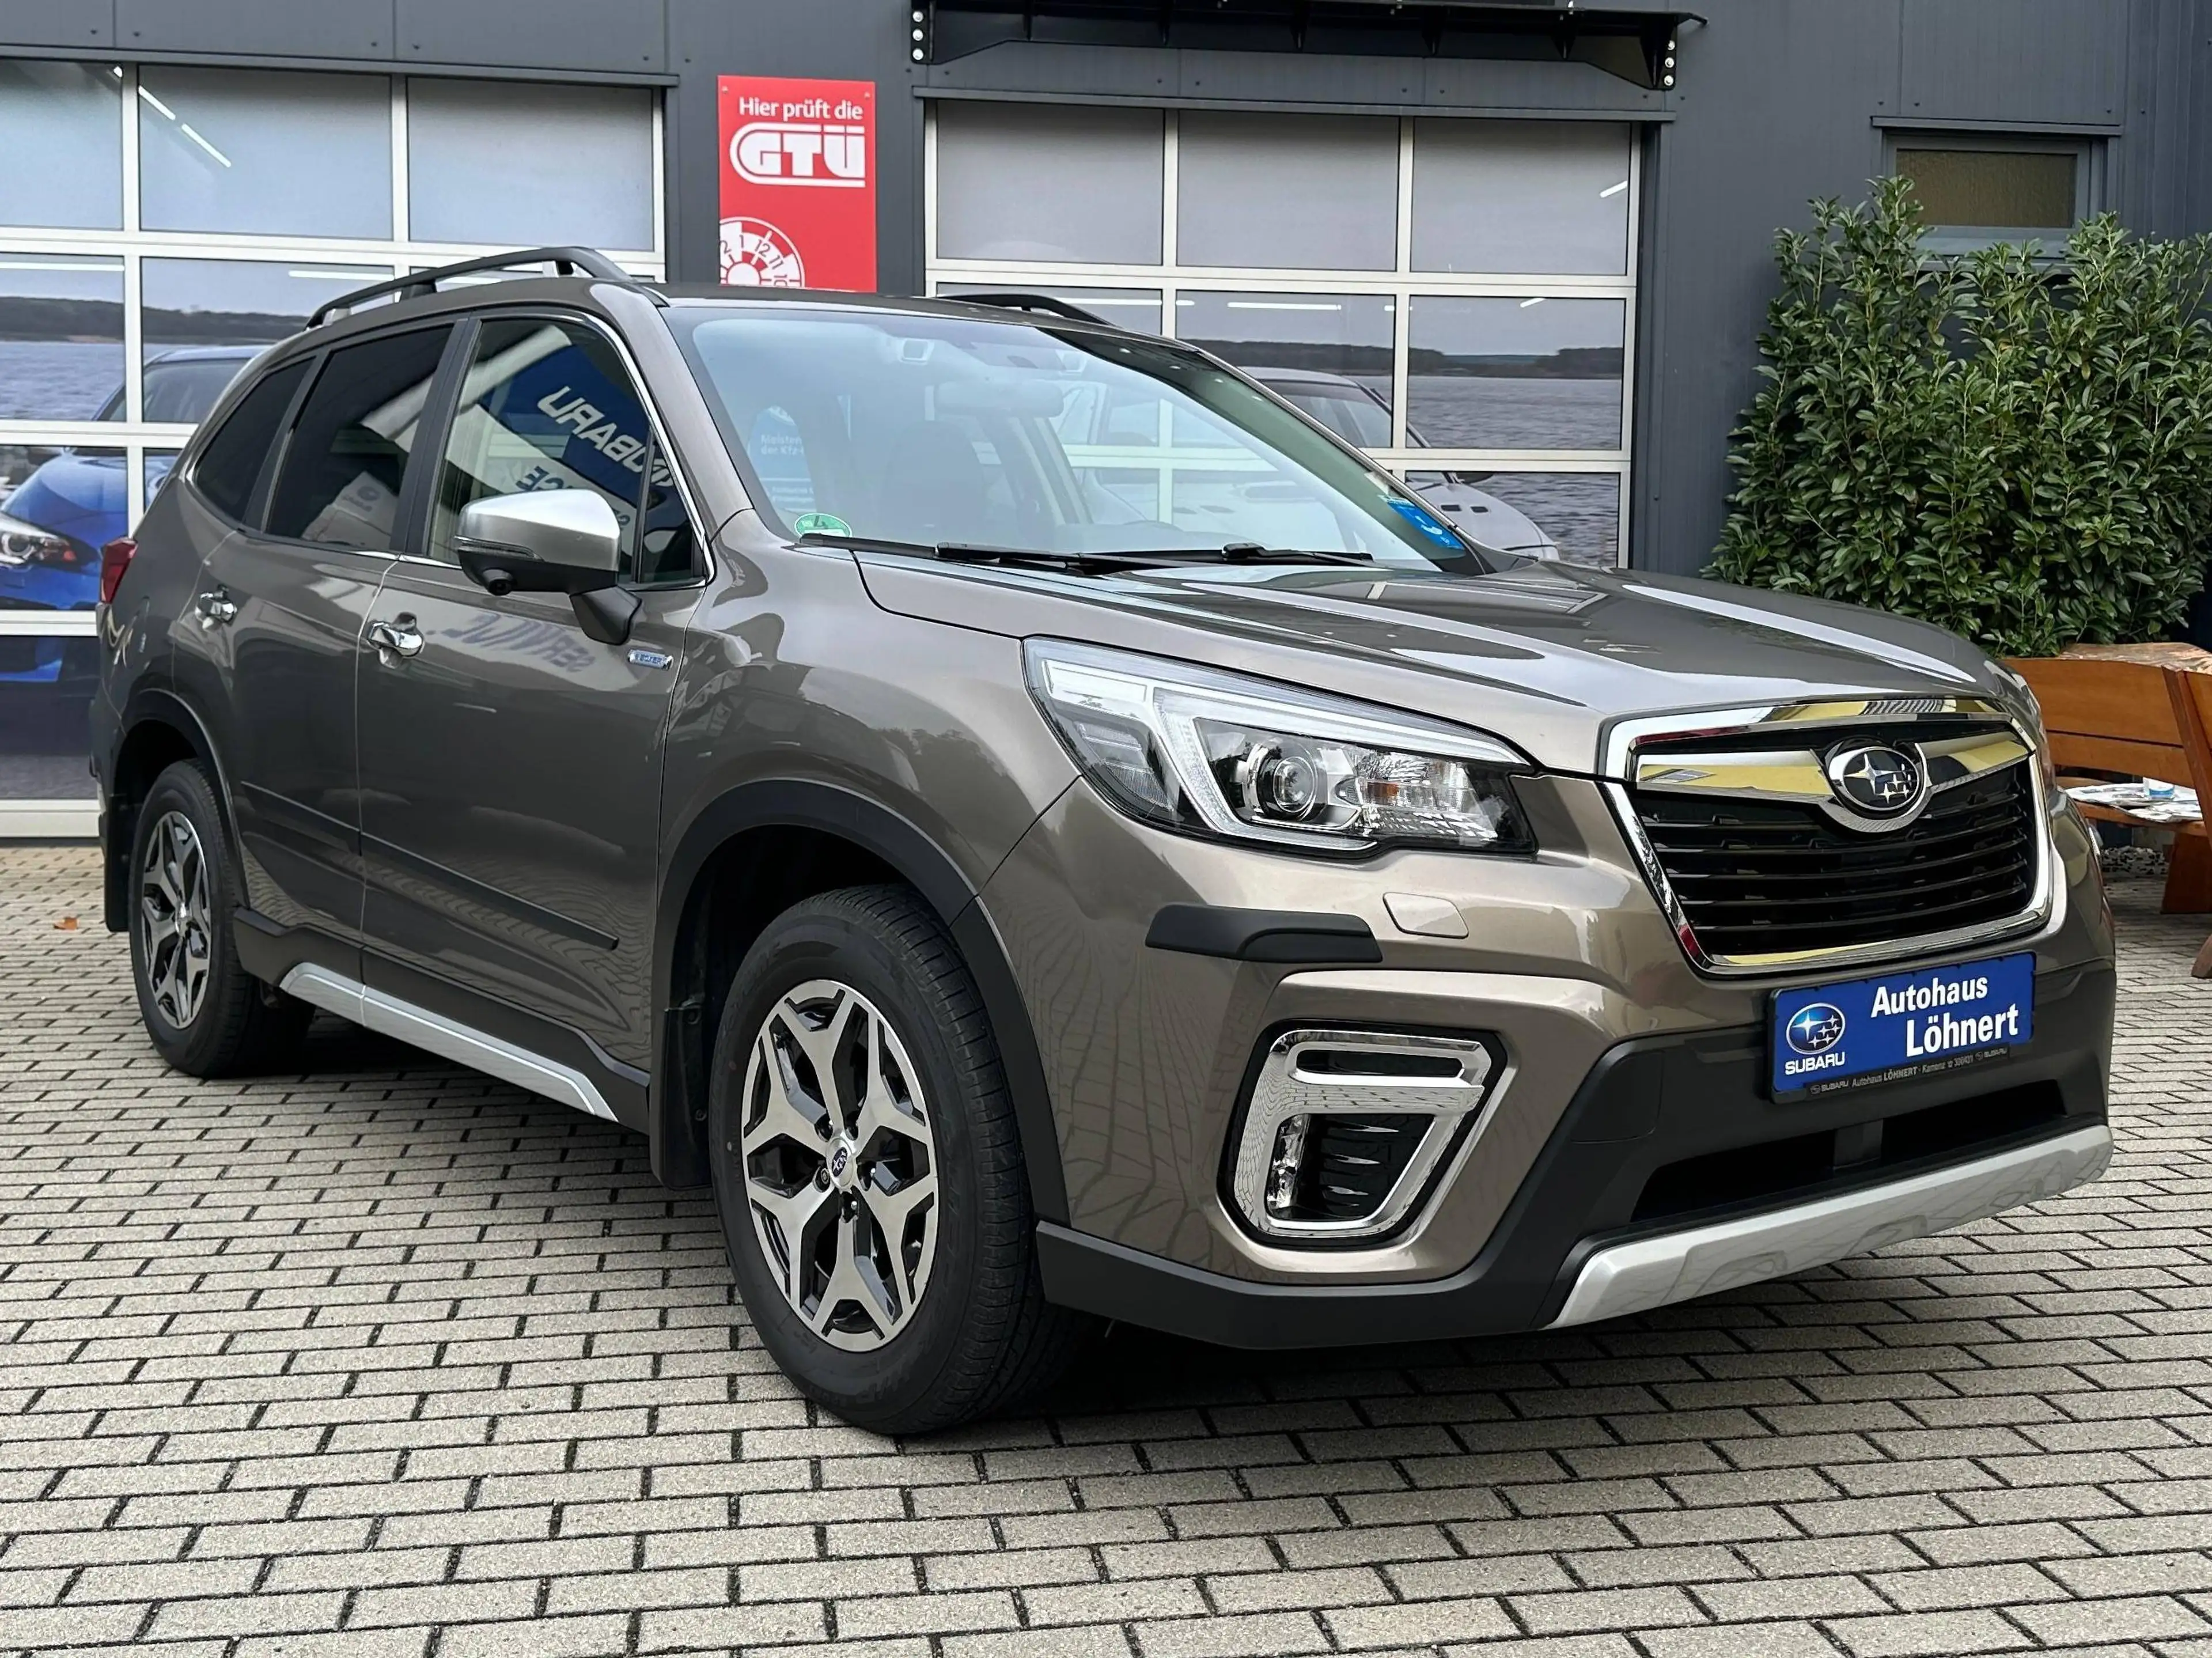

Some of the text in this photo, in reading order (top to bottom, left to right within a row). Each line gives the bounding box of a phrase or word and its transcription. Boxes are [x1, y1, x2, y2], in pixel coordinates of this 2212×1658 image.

[739, 96, 863, 122] Hier prüft die
[736, 124, 865, 180] GTÜ
[755, 239, 771, 258] 12
[768, 255, 784, 270] 11
[1870, 976, 1988, 1019] Autohaus
[1906, 1002, 2019, 1058] Löhnert
[1785, 1051, 1846, 1076] SUBARU
[1821, 1079, 1849, 1092] SUBARU
[1884, 1066, 1918, 1082] LÖHNERT
